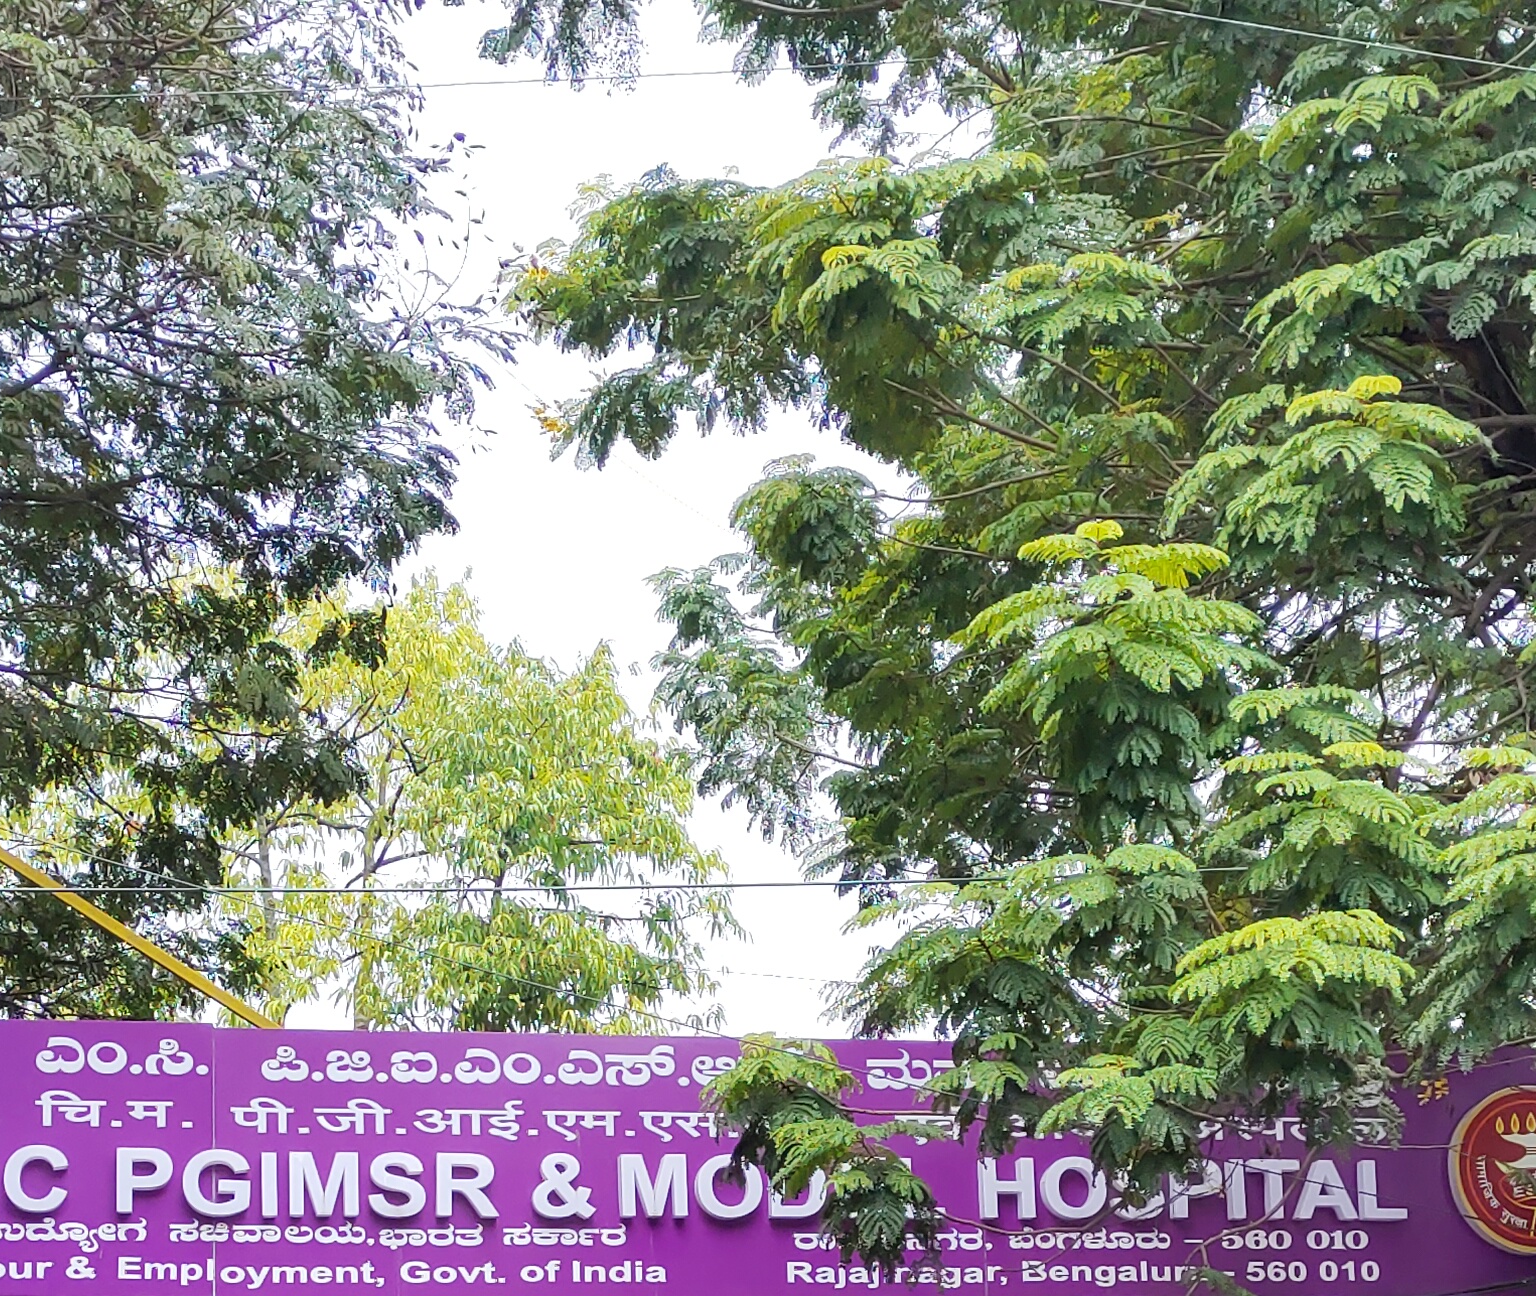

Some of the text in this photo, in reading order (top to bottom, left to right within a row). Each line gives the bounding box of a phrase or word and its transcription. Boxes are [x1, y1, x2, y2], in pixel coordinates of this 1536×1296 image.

[35, 1036, 209, 1075] ಎಂ.ಸಿ.
[116, 1149, 500, 1220] PGIMSR
[531, 1152, 597, 1219] &
[617, 1153, 947, 1219] MOD
[502, 1222, 627, 1247] ಸರ್ಕಾರ
[1221, 1229, 1292, 1250] 560
[1306, 1230, 1369, 1250] 010
[65, 1255, 97, 1280] &
[117, 1255, 385, 1293] Employment,
[399, 1260, 506, 1284] Govt.
[519, 1259, 561, 1283] of
[572, 1260, 667, 1283] India
[1246, 1261, 1307, 1282] 560
[1319, 1260, 1380, 1282] 010
